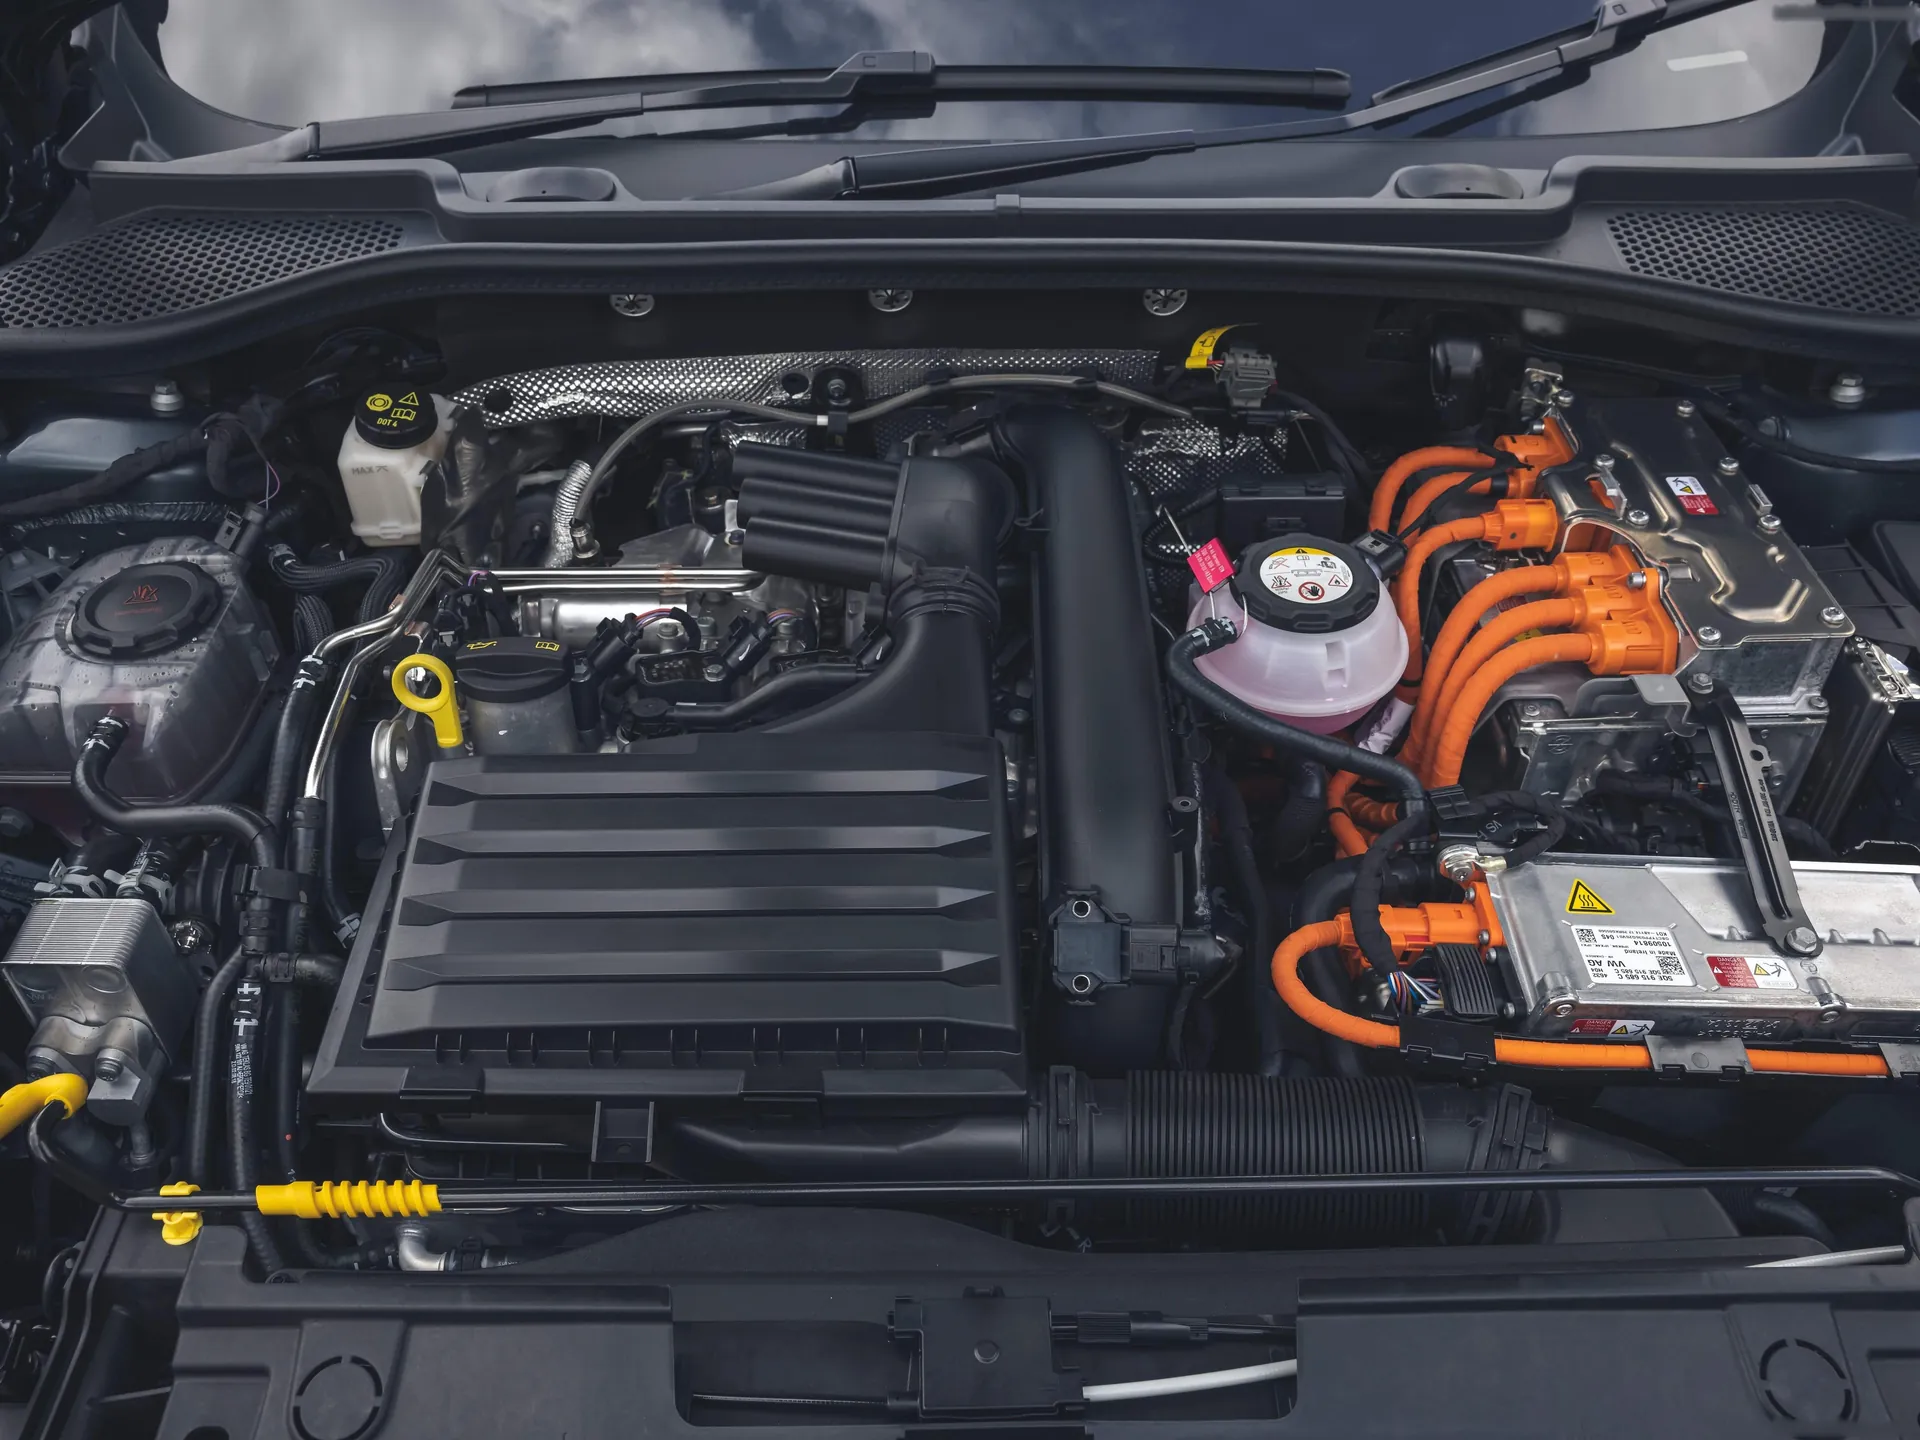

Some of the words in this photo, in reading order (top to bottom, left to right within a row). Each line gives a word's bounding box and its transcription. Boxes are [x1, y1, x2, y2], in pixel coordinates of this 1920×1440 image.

[376, 417, 392, 426] DOT
[392, 420, 398, 428] 4
[352, 466, 374, 475] MAX
